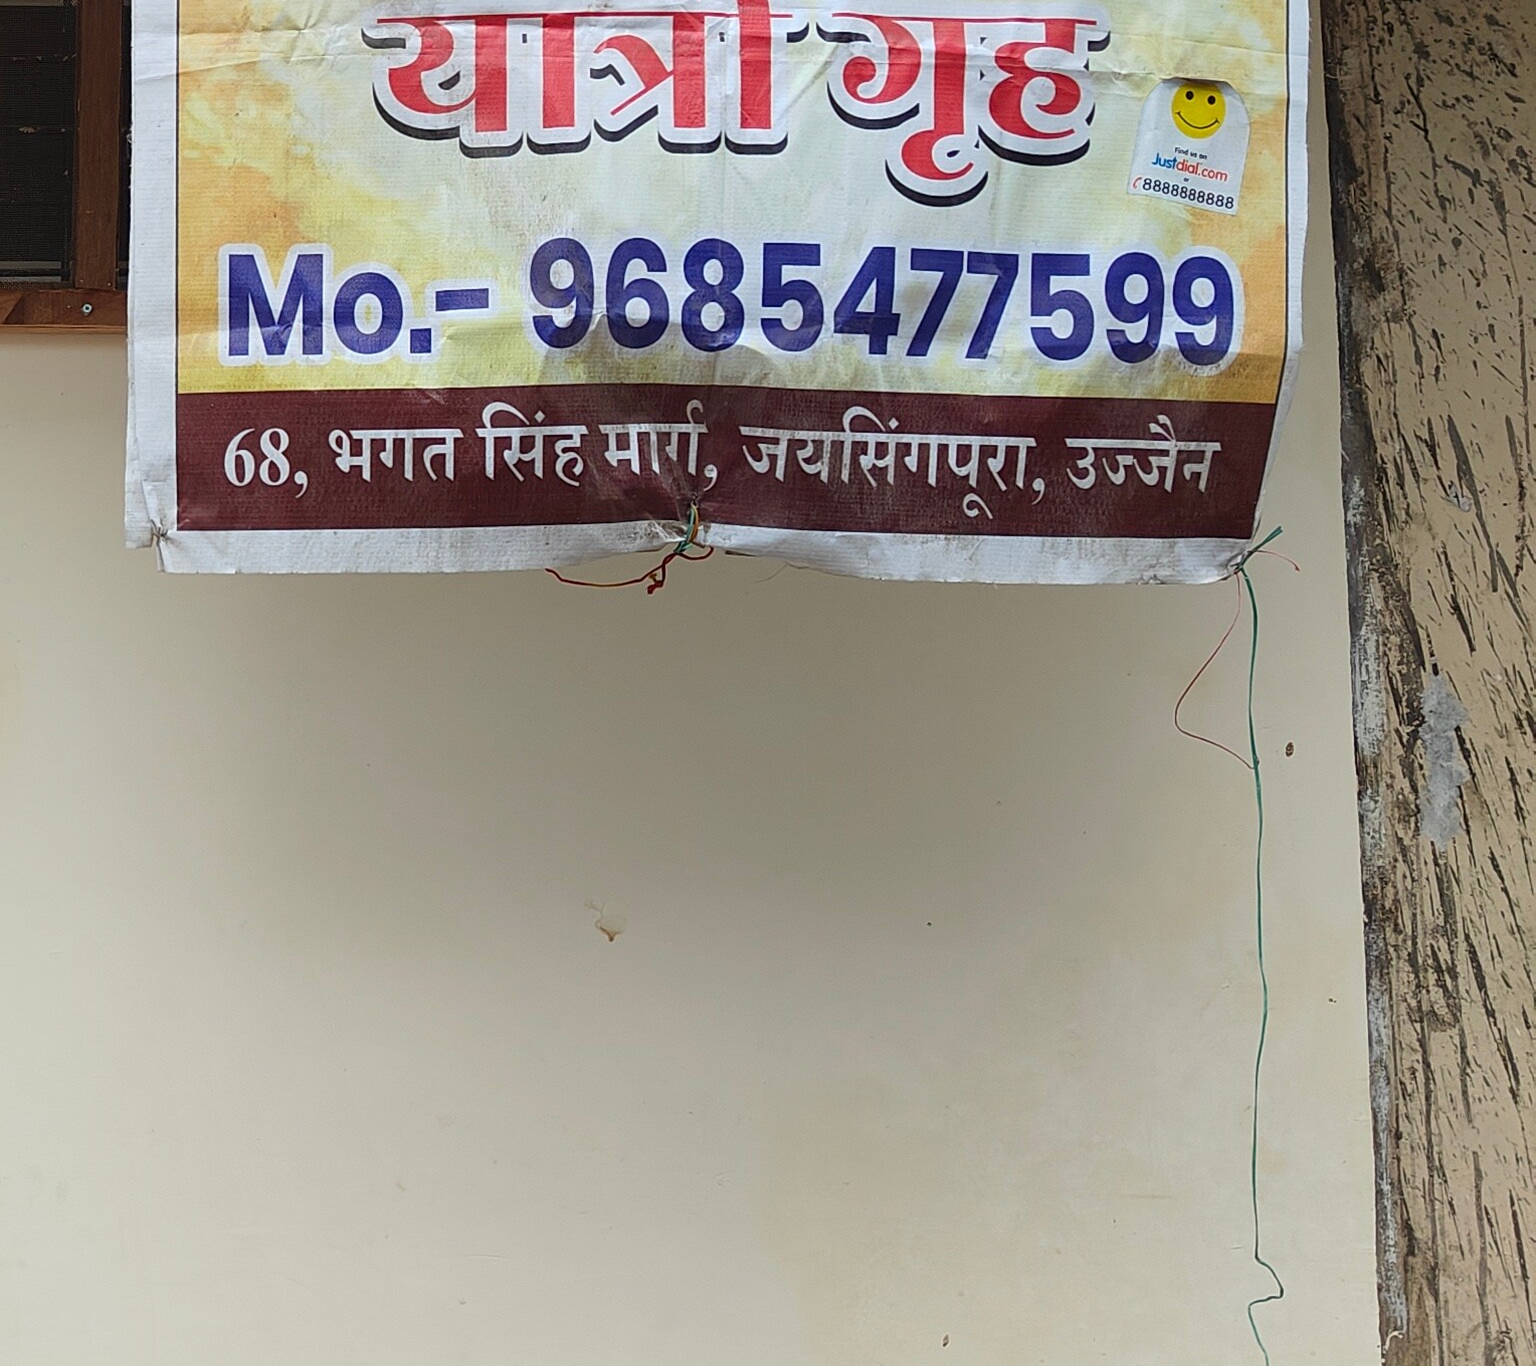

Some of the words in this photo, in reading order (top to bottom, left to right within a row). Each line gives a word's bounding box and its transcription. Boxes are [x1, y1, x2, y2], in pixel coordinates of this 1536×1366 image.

[832, 15, 1096, 181] गृह
[1152, 153, 1227, 182] Justdial.com
[1175, 147, 1188, 155] Find
[1142, 178, 1234, 209] 8888888888
[530, 238, 1236, 366] 9685477599
[224, 427, 308, 498] 68,
[328, 428, 464, 481] भगत
[475, 401, 589, 487] सिंह
[599, 399, 718, 491] मार्ग,
[739, 405, 1045, 519] जयसिंगपूरा,
[1065, 415, 1221, 492] उज्जैन
